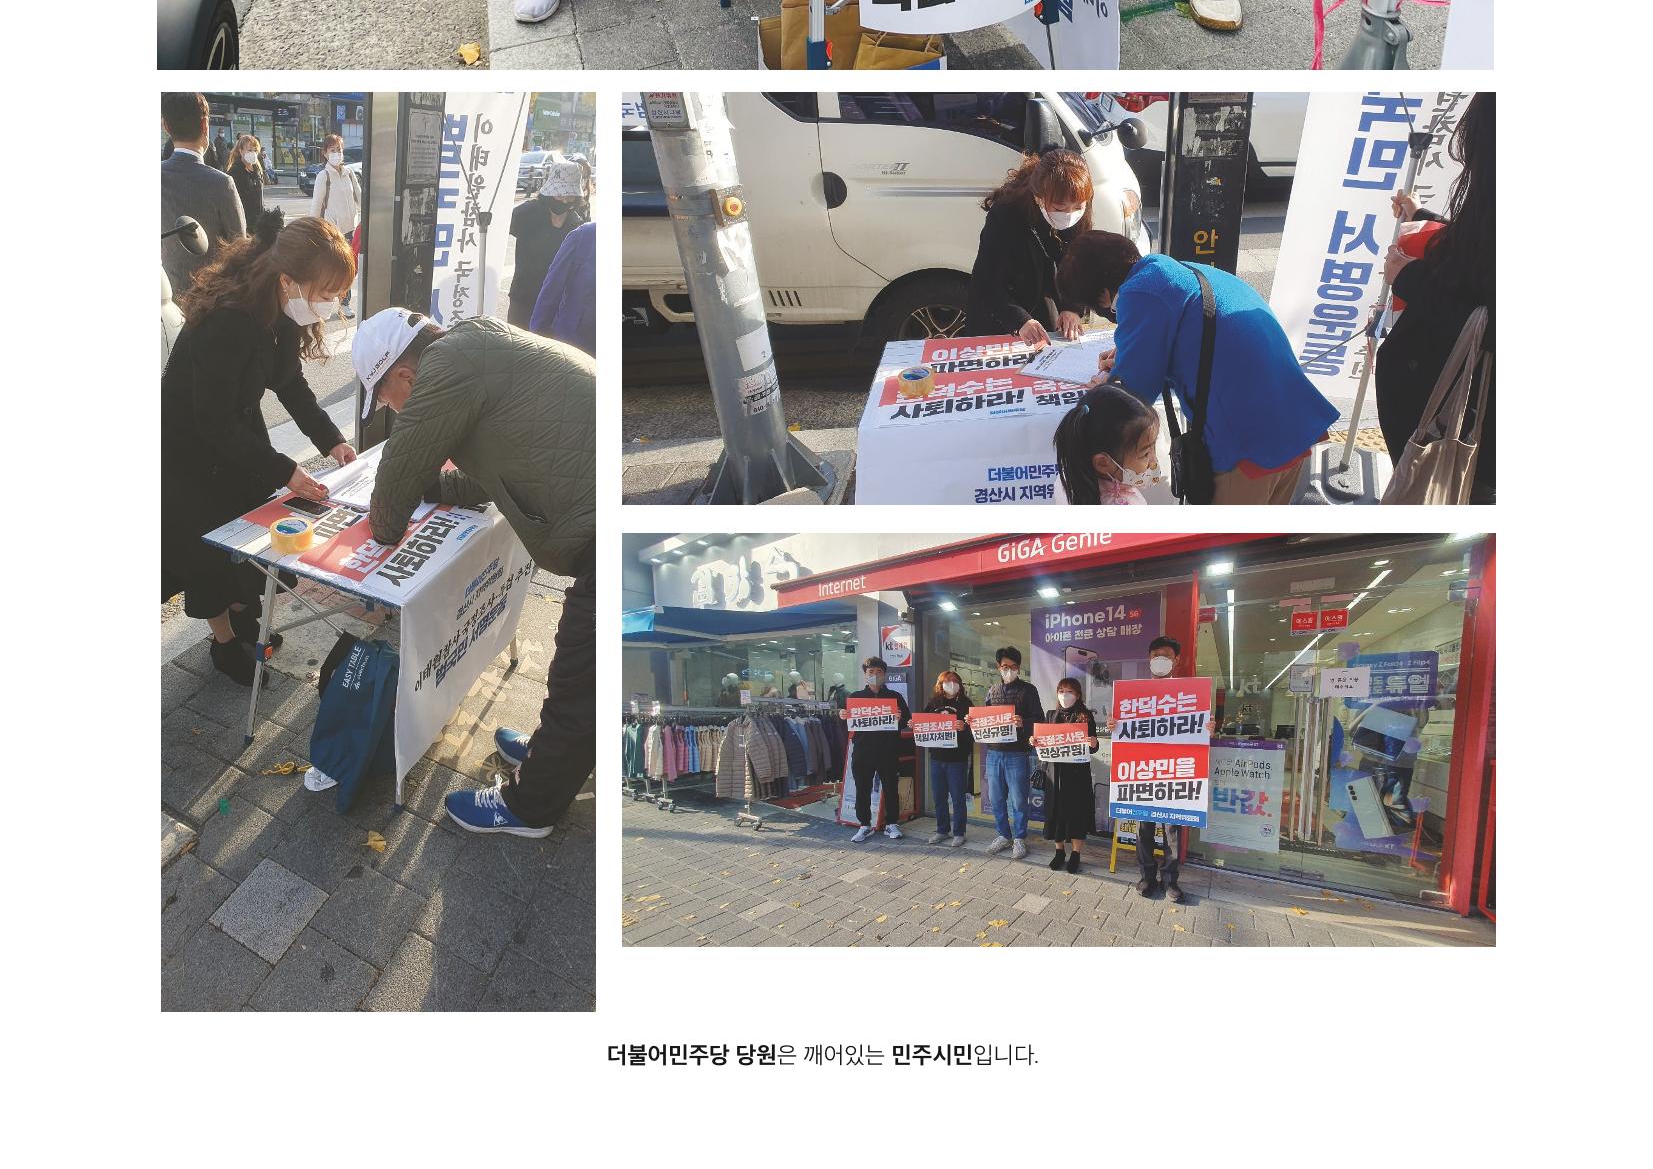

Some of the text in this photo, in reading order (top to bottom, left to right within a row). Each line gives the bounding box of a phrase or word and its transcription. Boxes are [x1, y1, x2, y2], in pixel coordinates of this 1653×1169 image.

[895, 377, 1015, 405] 덕수는
[890, 389, 1026, 420] 사퇴하라!
[974, 486, 1016, 504] 경산시
[818, 574, 867, 597] Internet
[1045, 630, 1072, 643] 아이폰
[1096, 626, 1117, 638] 상담
[1120, 623, 1143, 636] 매장
[342, 668, 353, 688] EASY
[348, 645, 362, 669] TABLE
[1119, 691, 1198, 719] 한덕수는
[851, 715, 896, 729] 사퇴하라!
[973, 725, 1014, 740] 진상규명!
[1118, 712, 1205, 740] 사퇴하라!
[1117, 757, 1196, 781] 이상민을
[1241, 769, 1271, 780] Watch
[1116, 781, 1203, 802] 파면하라!
